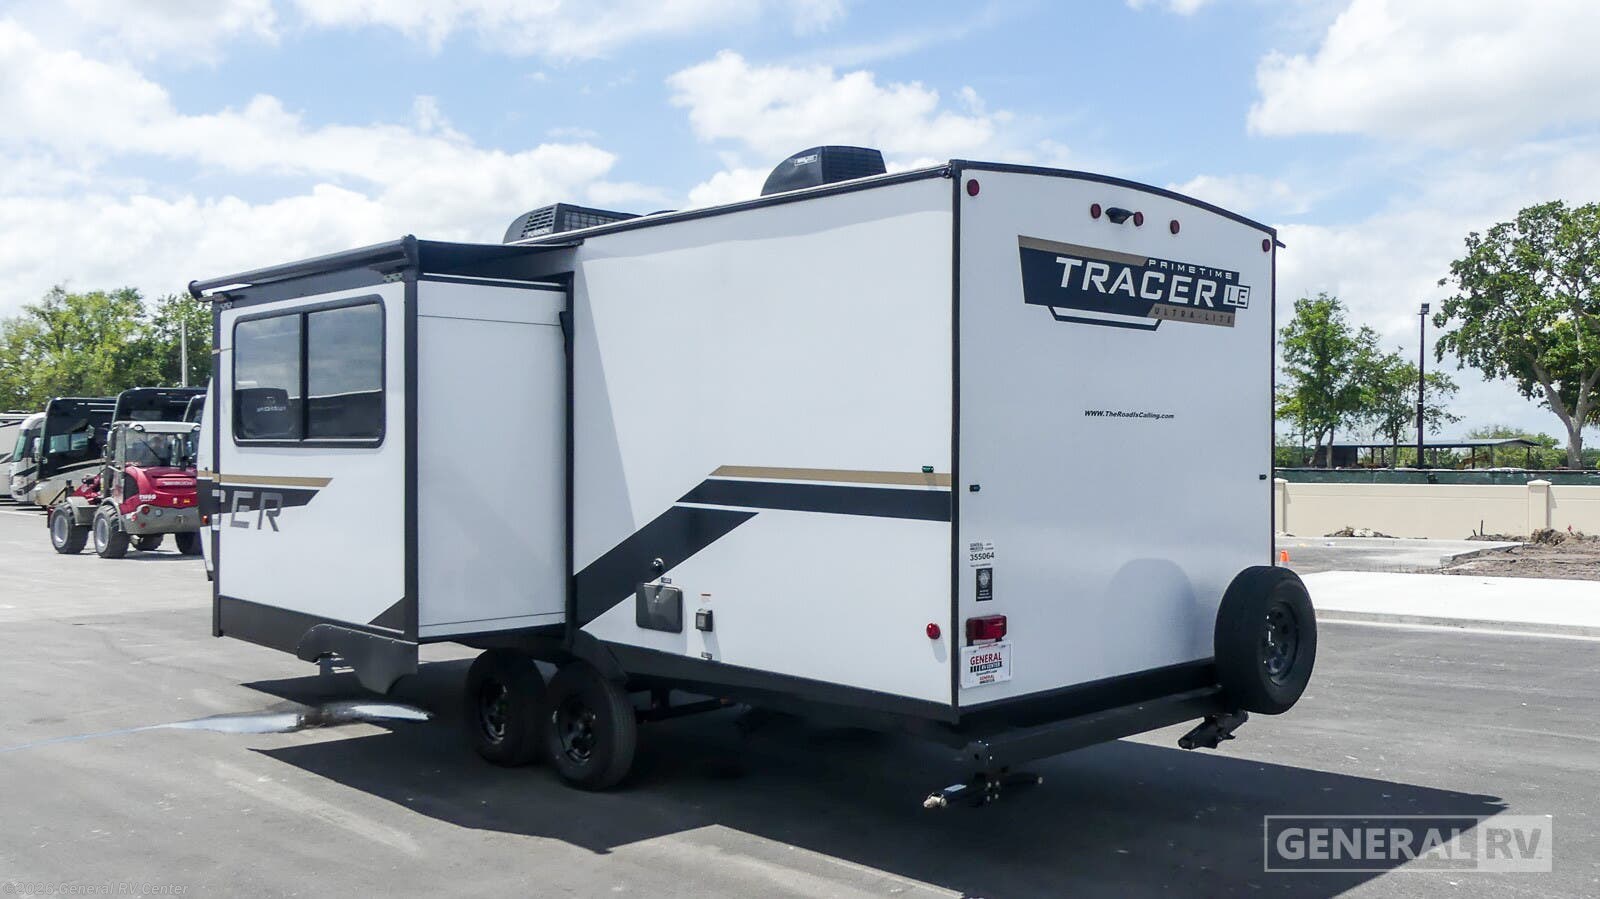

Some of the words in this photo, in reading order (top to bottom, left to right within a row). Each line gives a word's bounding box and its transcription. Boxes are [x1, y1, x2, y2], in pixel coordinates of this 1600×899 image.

[1148, 259, 1233, 280] PRIMETIME
[1055, 256, 1217, 307] TRACER
[1225, 286, 1249, 307] LE
[1084, 410, 1175, 420] WWW.TheRoadIsCalling.com
[970, 552, 995, 561] 355064
[970, 652, 1002, 666] GENERAL
